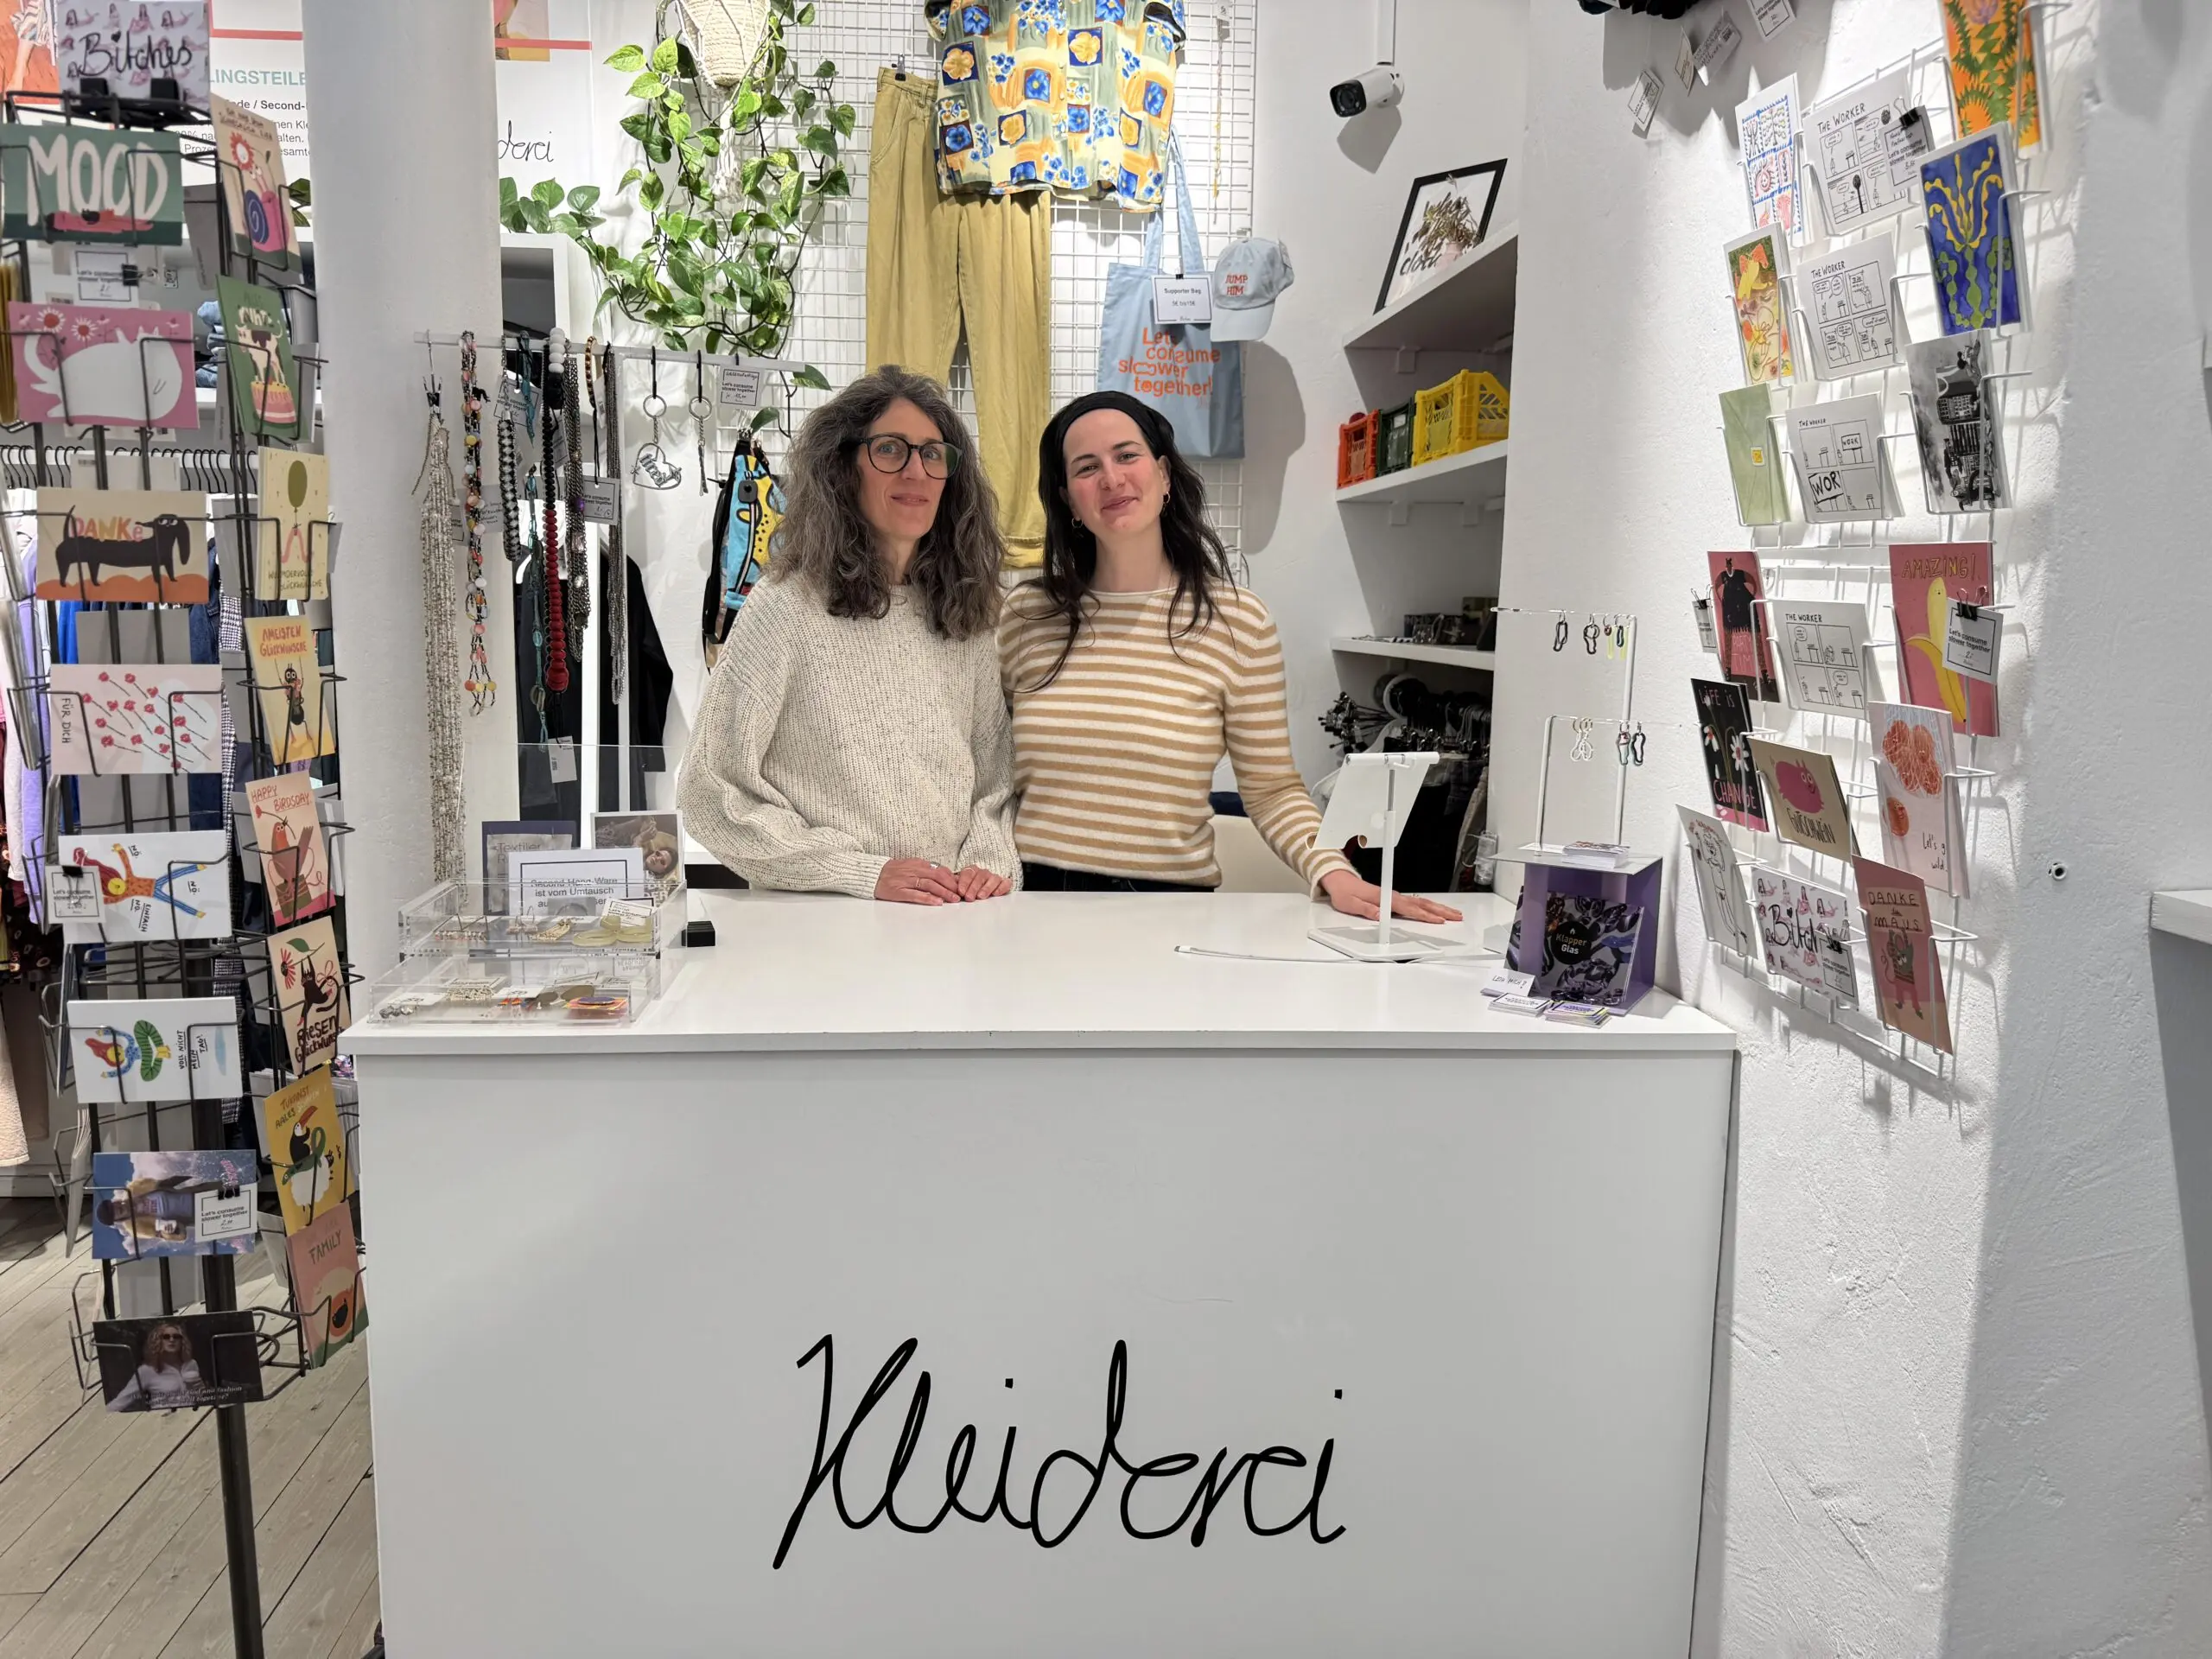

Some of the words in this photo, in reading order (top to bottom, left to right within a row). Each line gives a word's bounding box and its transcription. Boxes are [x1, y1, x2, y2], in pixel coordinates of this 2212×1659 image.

[79, 31, 193, 77] Bitches
[210, 68, 306, 86] INGSTEILE
[1817, 121, 1830, 134] THE
[1833, 103, 1866, 126] WORKER
[28, 133, 169, 228] MOOD
[1811, 270, 1821, 278] THE
[1822, 261, 1846, 276] WORKER
[1146, 347, 1221, 364] consume
[1134, 375, 1212, 397] together!
[1948, 628, 1961, 638] Let's
[1961, 632, 1987, 646] consume
[1948, 635, 1965, 647] slower
[1966, 640, 1991, 653] together
[61, 698, 71, 718] FÜR
[61, 721, 71, 743] DICH
[251, 785, 277, 803] HAPPY
[497, 842, 541, 853] Textiler
[1923, 831, 1937, 850] Let's
[535, 887, 548, 897] ist
[569, 887, 614, 896] Umtausch
[1868, 892, 1918, 906] DANKE
[141, 904, 152, 932] EINFACH
[1556, 933, 1587, 946] Klapper
[1561, 944, 1580, 955] Glas
[217, 1206, 245, 1215] consume
[222, 1210, 248, 1218] together
[308, 1230, 341, 1264] FAMILY
[772, 1333, 1347, 1571] Kleiderei
